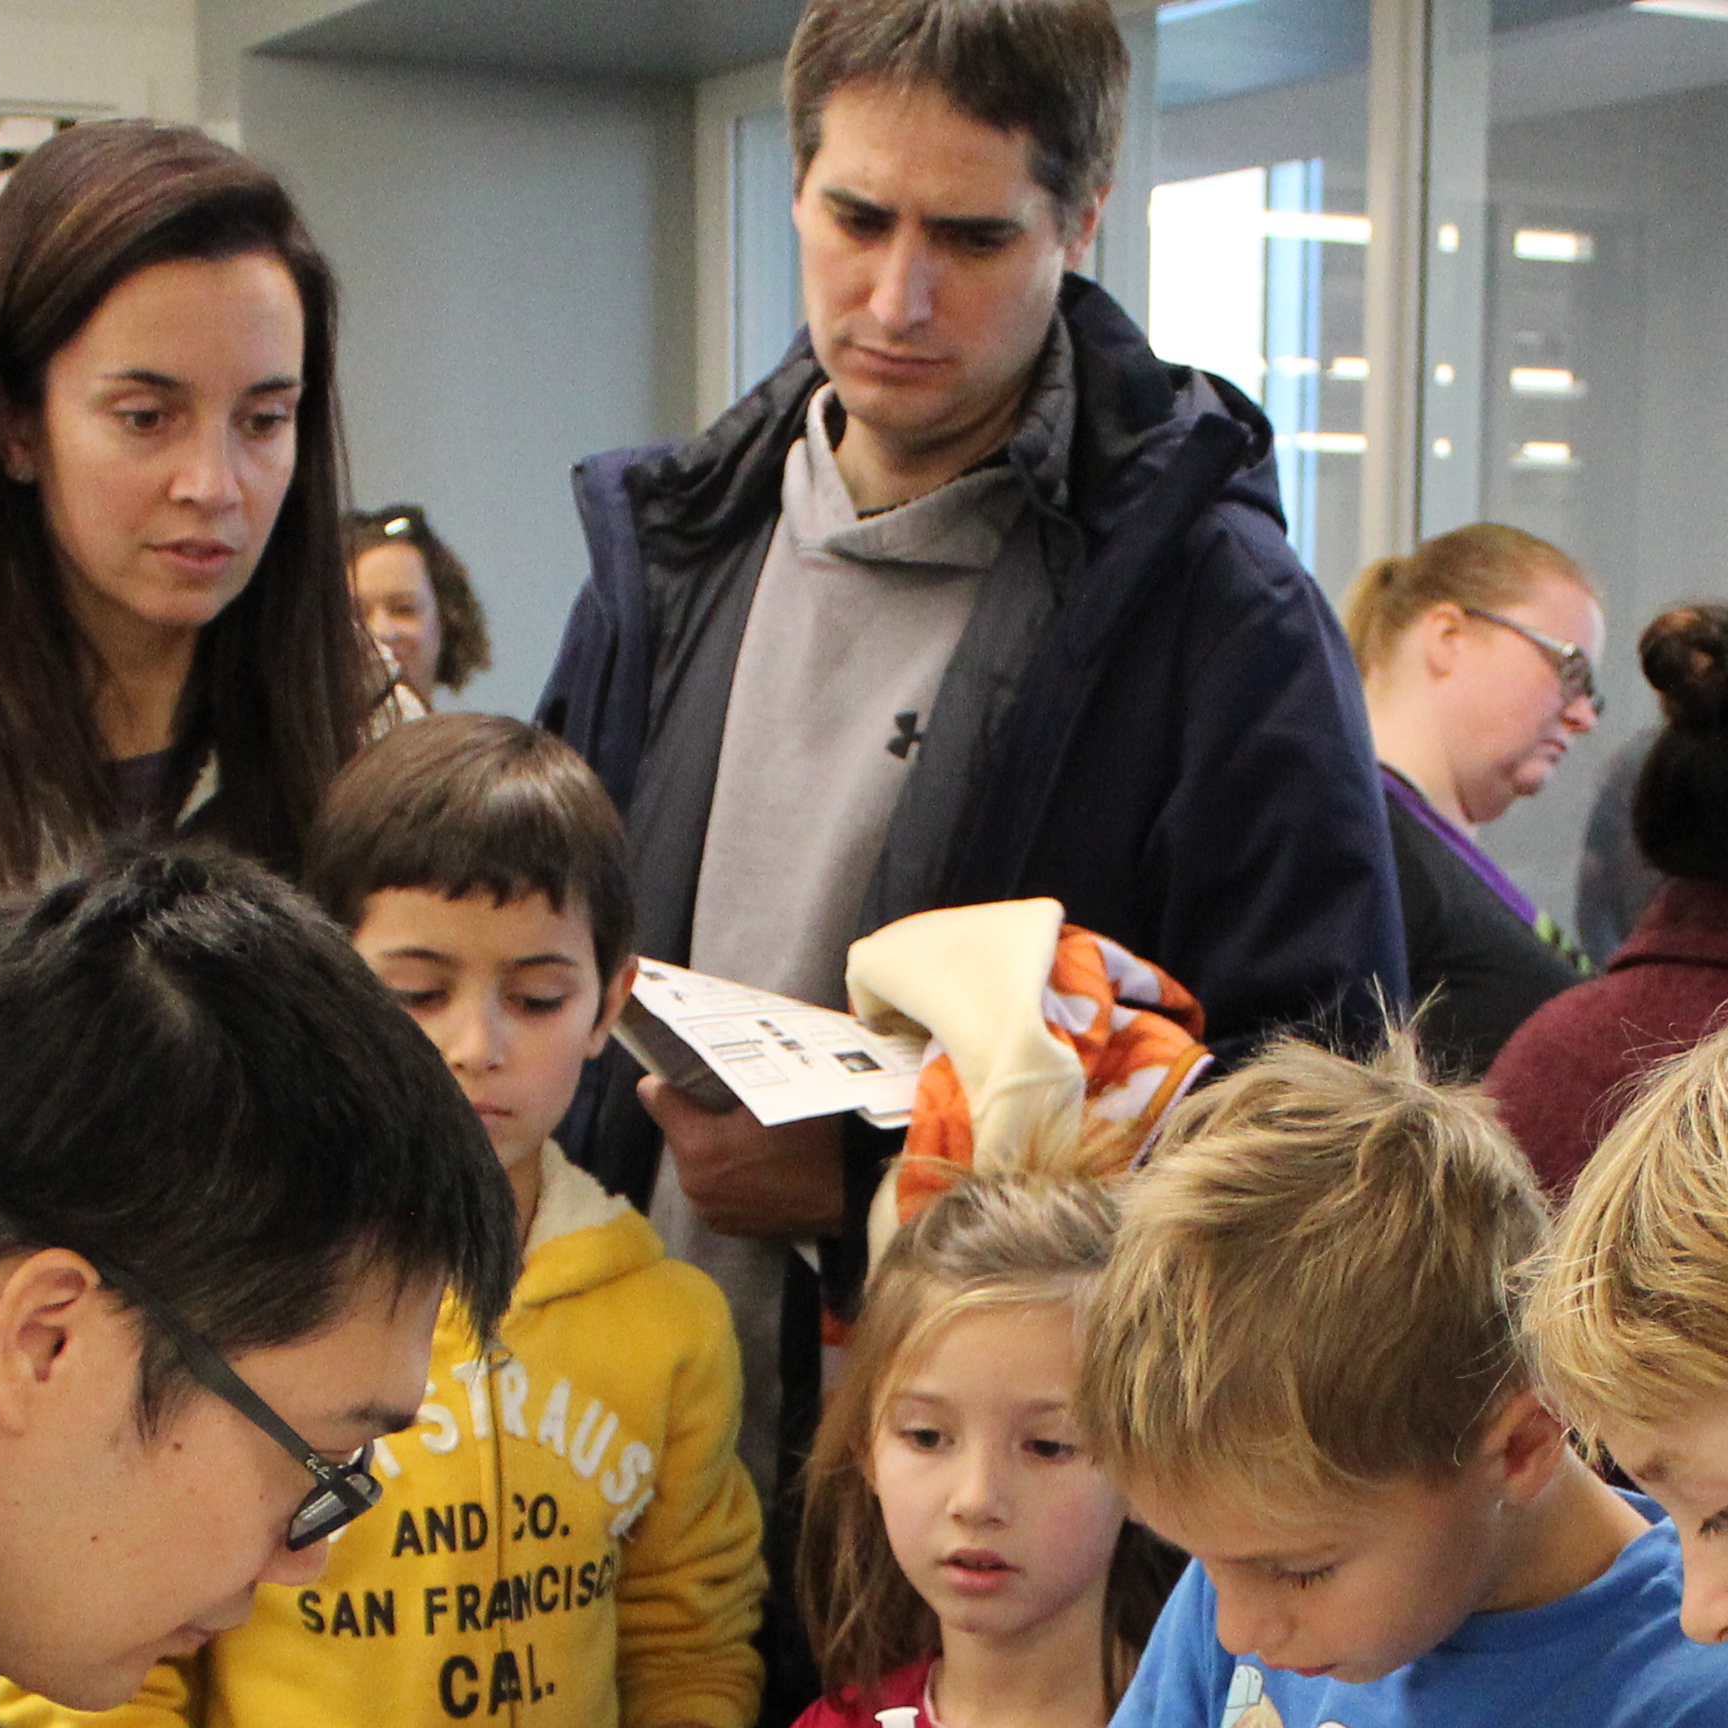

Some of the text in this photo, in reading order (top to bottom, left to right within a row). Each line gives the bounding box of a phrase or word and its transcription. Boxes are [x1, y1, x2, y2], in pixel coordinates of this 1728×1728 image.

[392, 1502, 488, 1558] AND
[297, 1590, 396, 1638] SAN
[438, 1643, 556, 1719] CAL.
